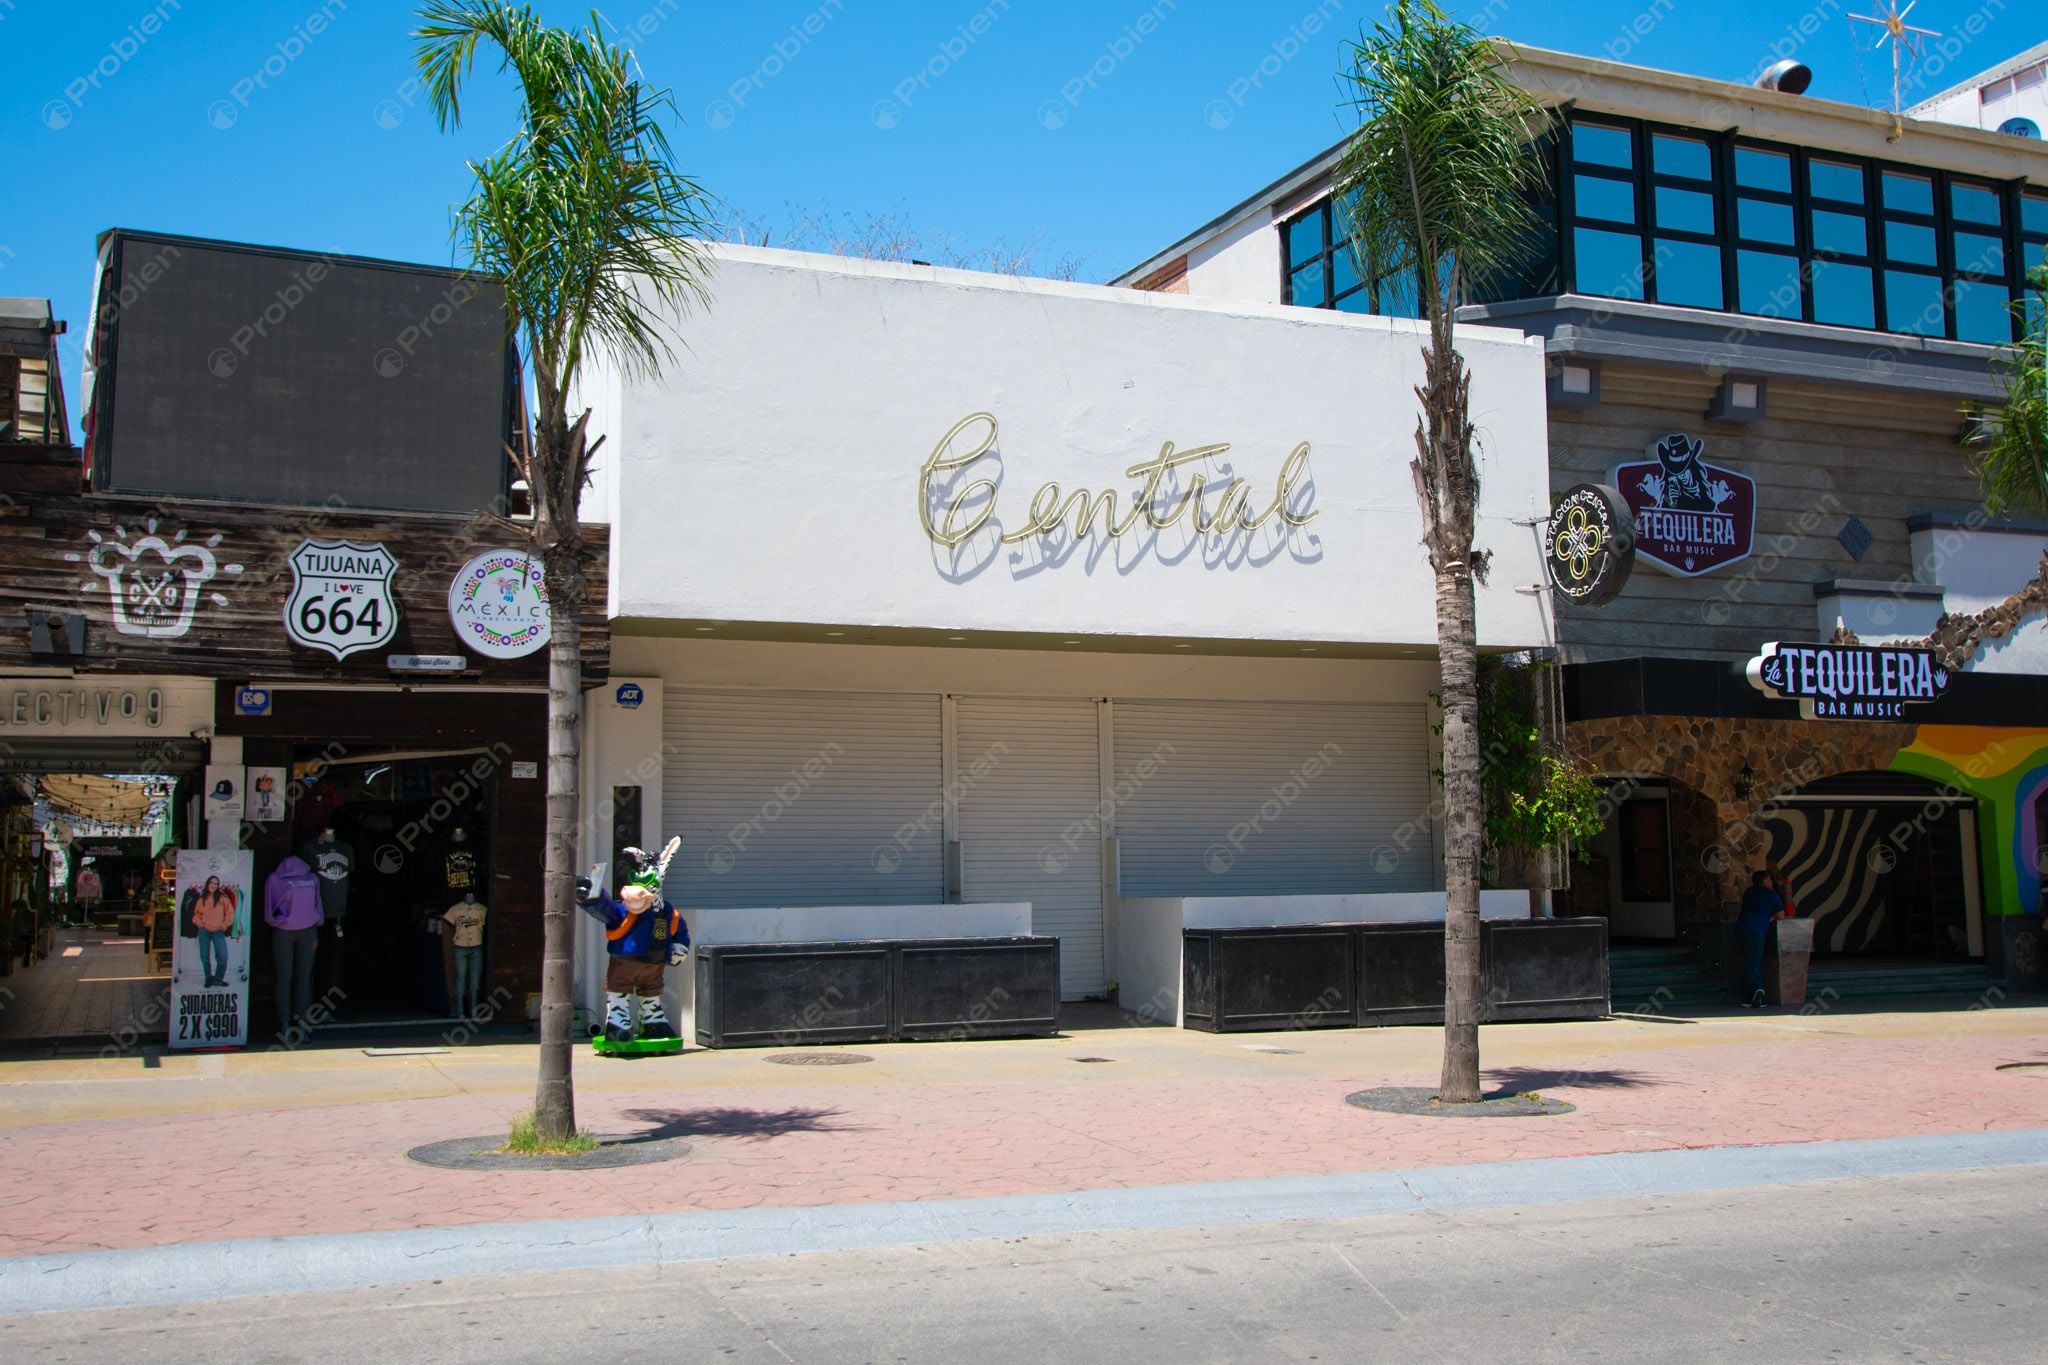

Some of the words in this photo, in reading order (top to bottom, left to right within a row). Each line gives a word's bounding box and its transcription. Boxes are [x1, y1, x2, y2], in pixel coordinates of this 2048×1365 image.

[919, 411, 1319, 548] Central
[1640, 511, 1736, 545] TEQUILERA
[1664, 544, 1681, 553] BAR
[1686, 545, 1715, 556] MUSIC
[304, 554, 383, 575] TIJUANA
[300, 595, 382, 636] 664
[1765, 658, 1784, 686] La
[1779, 648, 1935, 699] TEQUILERA
[620, 690, 639, 699] ADT
[1818, 703, 1847, 715] BAR
[1853, 703, 1901, 716] MUSIC
[135, 740, 175, 748] LUNE
[67, 760, 106, 769] 2014
[180, 993, 237, 1015] SUDADERAS
[179, 1015, 188, 1040] 2
[205, 1014, 238, 1041] $990
